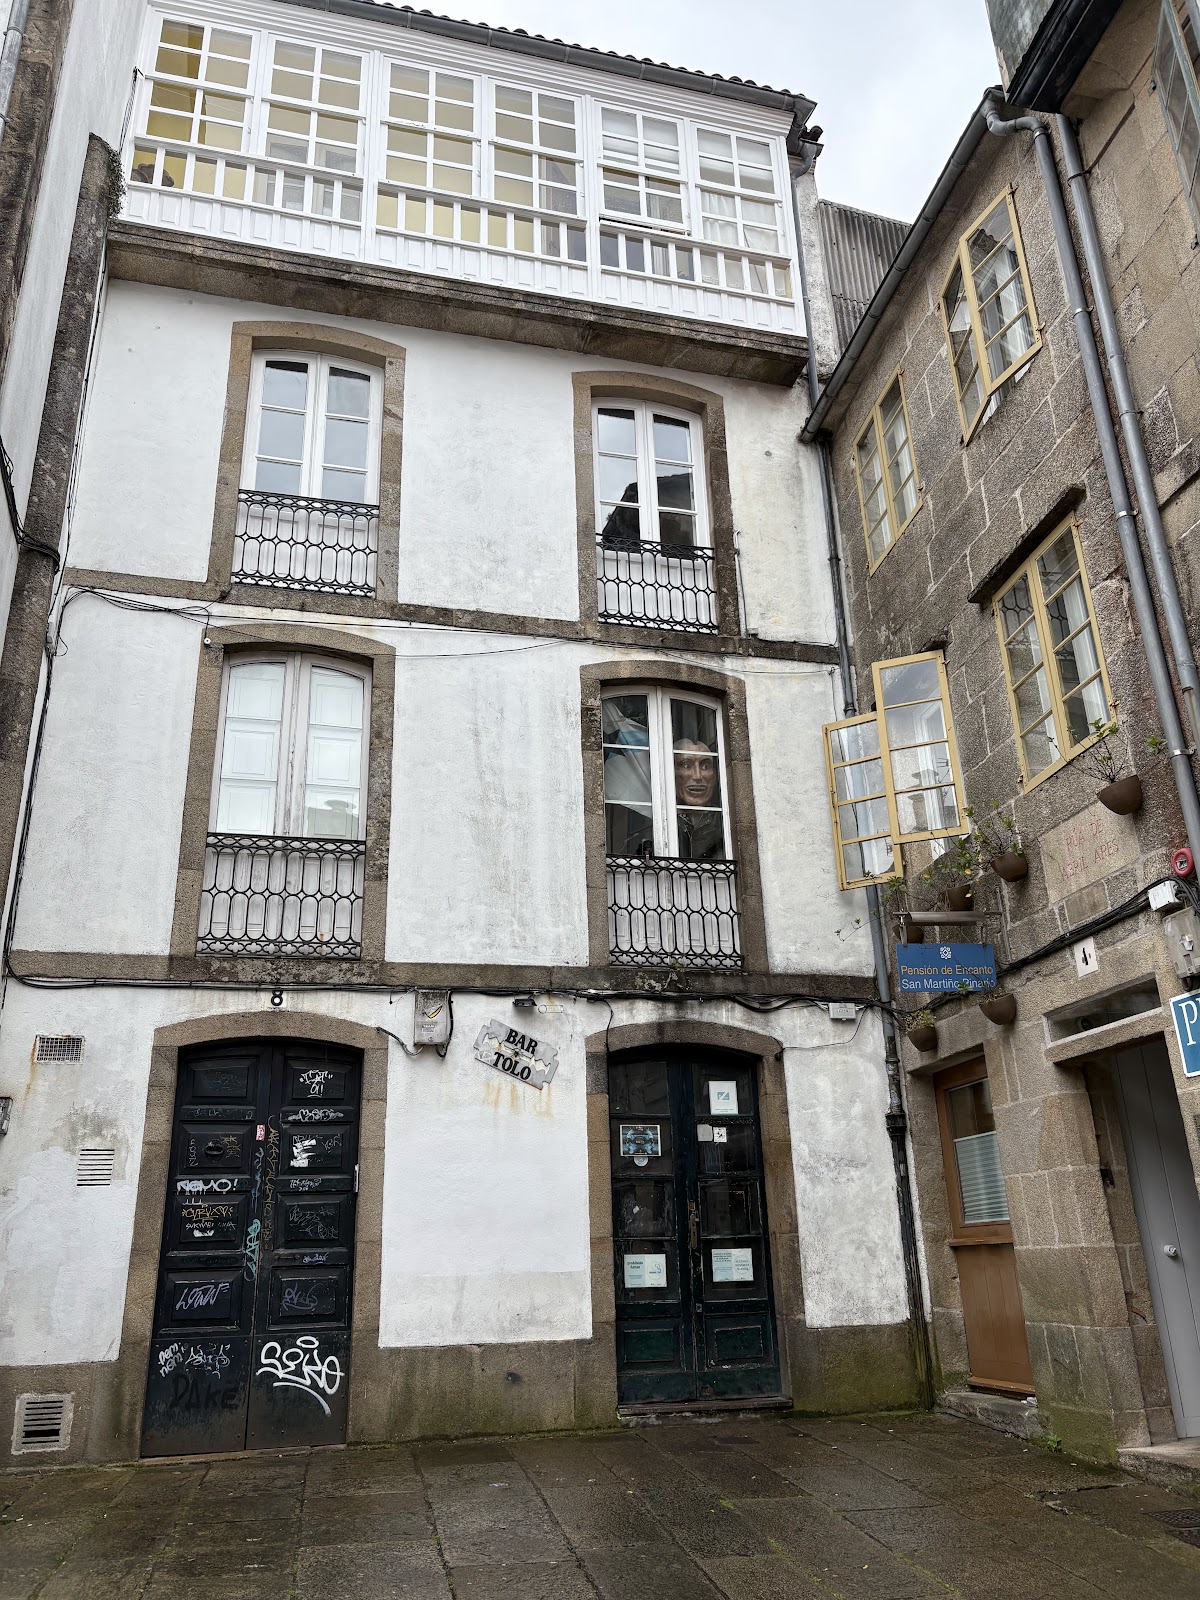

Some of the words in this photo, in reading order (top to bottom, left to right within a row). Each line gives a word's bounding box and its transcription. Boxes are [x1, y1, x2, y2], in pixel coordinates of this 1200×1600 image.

[900, 964, 939, 976] Pensión
[940, 965, 953, 975] de
[955, 964, 994, 975] Encanto
[901, 978, 922, 990] San
[923, 977, 960, 989] Martiño
[271, 989, 283, 1006] 8
[505, 1028, 538, 1055] BAR
[492, 1051, 532, 1081] TOLO
